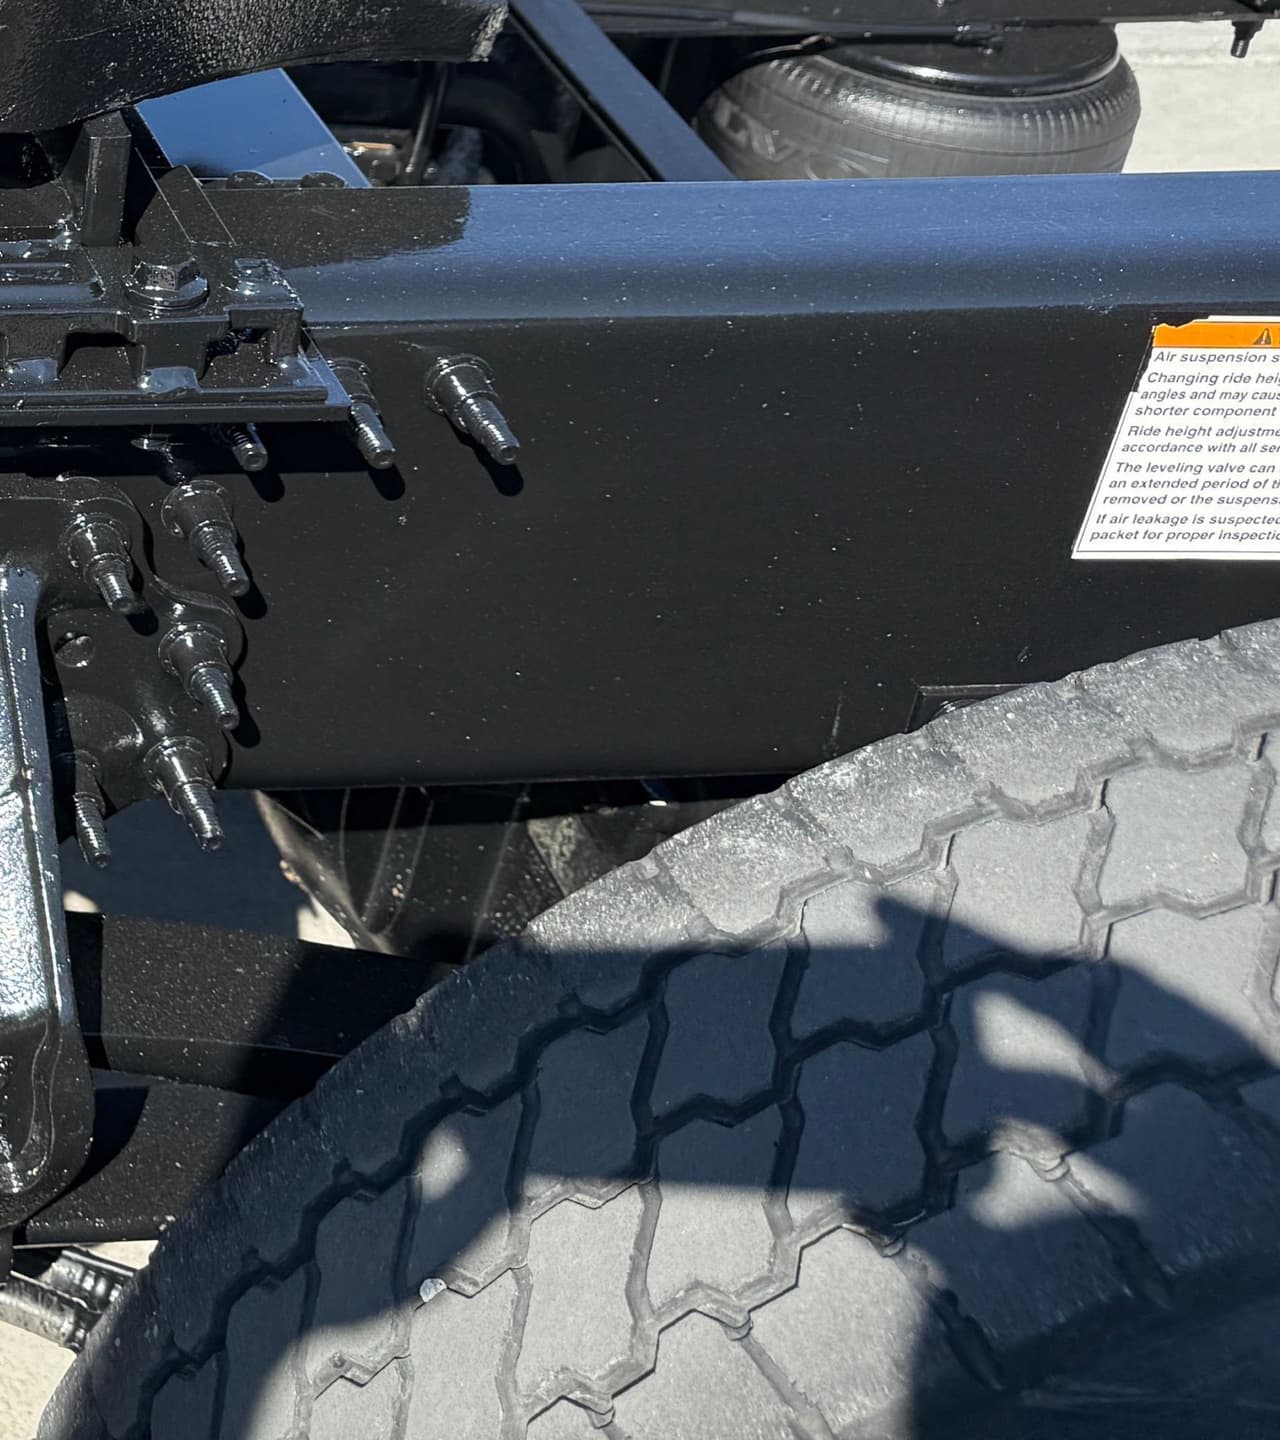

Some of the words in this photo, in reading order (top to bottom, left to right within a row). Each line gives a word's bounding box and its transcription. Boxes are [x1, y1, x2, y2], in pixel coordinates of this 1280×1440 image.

[1153, 351, 1177, 363] Air
[1179, 351, 1267, 365] suspension
[1147, 372, 1219, 386] Changing
[1222, 372, 1252, 384] ride
[1255, 372, 1280, 387] hei
[1140, 389, 1186, 402] angles
[1189, 389, 1217, 400] and
[1219, 391, 1248, 403] may
[1134, 405, 1190, 416] shorter
[1192, 406, 1278, 419] component
[1127, 425, 1162, 437] Ride
[1165, 425, 1213, 440] height
[1121, 442, 1204, 453] accordance
[1207, 442, 1237, 453] with
[1239, 442, 1258, 453] all
[1116, 461, 1143, 473] The
[1146, 462, 1204, 476] leveling
[1208, 462, 1246, 473] valve
[1249, 464, 1276, 473] can
[1108, 480, 1127, 489] an
[1130, 478, 1200, 489] extended
[1200, 478, 1250, 491] period
[1252, 478, 1269, 489] of
[1103, 494, 1168, 505] removed
[1170, 496, 1187, 505] or
[1190, 494, 1214, 505] the
[1216, 496, 1280, 508] suspens
[1095, 513, 1107, 524] If
[1109, 514, 1130, 524] air
[1132, 513, 1189, 527] leakage
[1191, 514, 1205, 525] is
[1089, 529, 1140, 543] packet
[1142, 530, 1164, 540] for
[1164, 531, 1216, 543] proper
